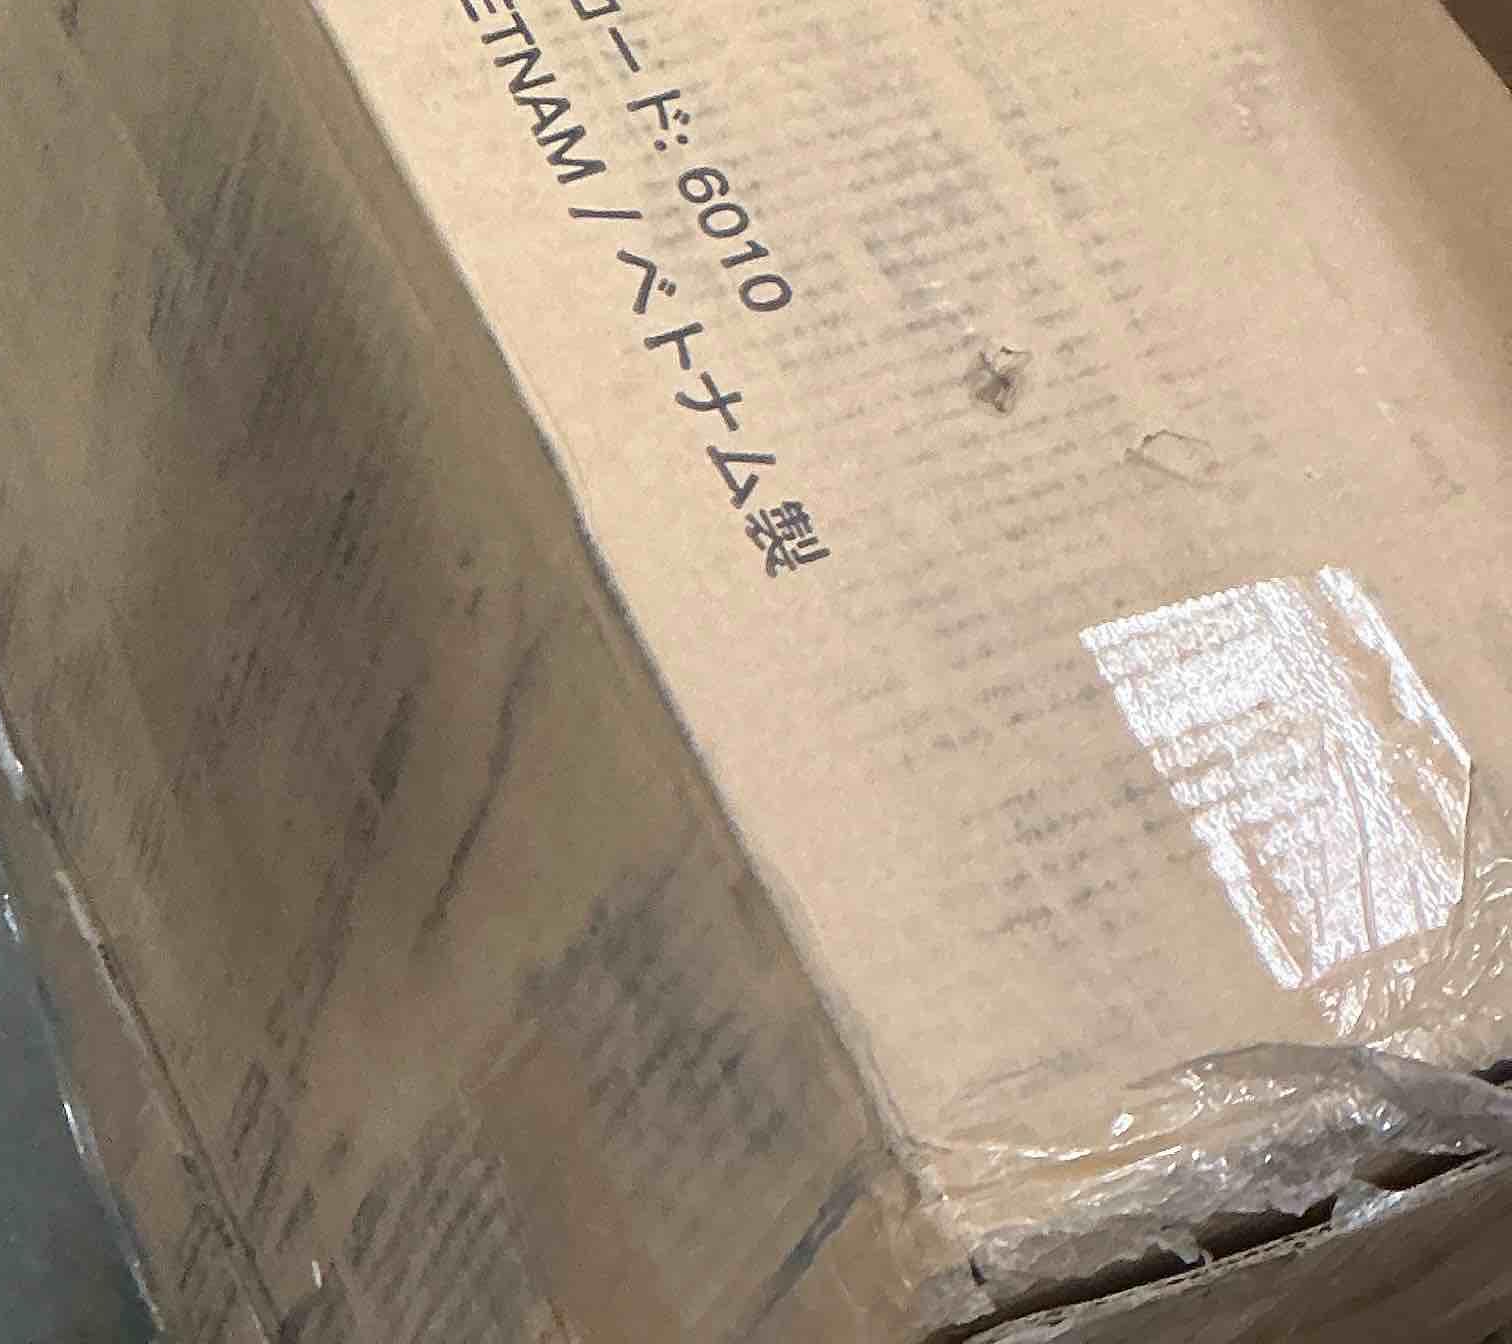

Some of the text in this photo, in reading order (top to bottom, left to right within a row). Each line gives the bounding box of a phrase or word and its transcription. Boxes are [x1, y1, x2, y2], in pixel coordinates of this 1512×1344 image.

[677, 166, 793, 313] 6010
[567, 207, 643, 219] /
[617, 249, 831, 579] ベトナム製
